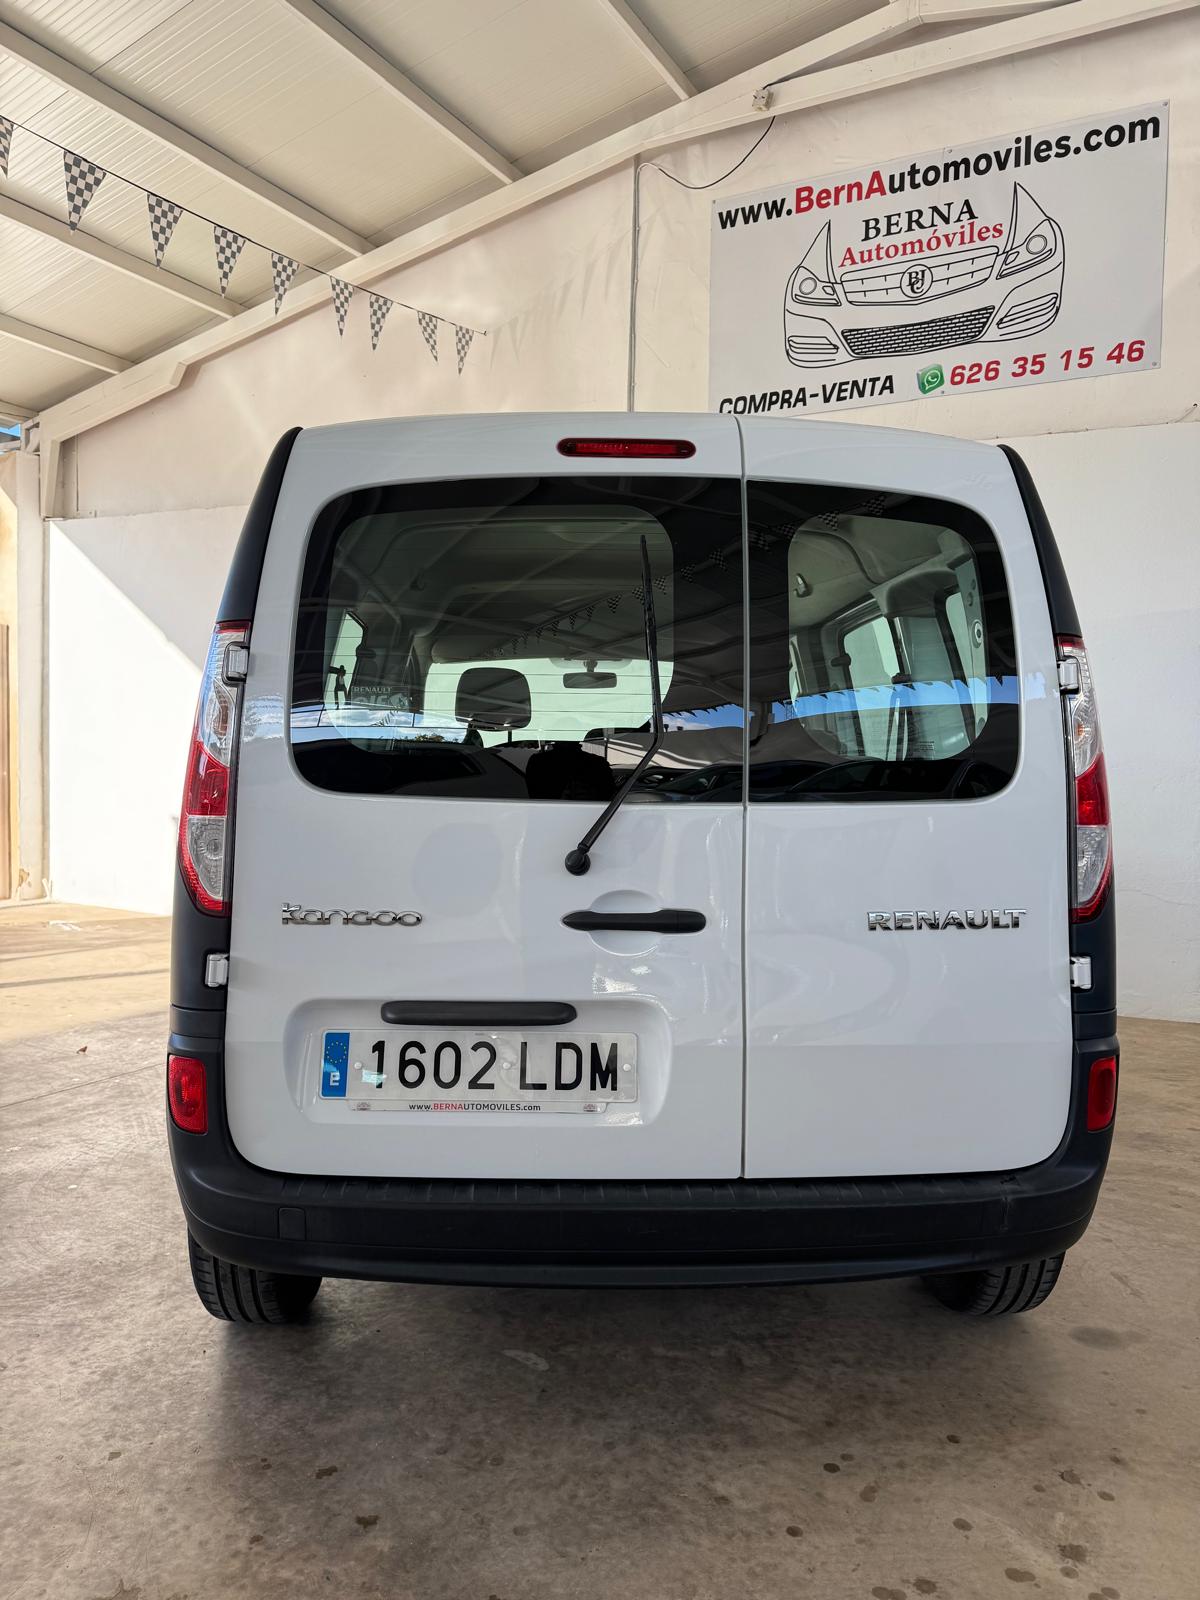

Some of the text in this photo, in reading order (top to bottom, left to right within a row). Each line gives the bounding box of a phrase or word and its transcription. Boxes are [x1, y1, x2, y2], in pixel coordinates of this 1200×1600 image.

[718, 116, 1160, 230] www.BernAutomoviles.com
[861, 198, 978, 242] BERNA
[838, 222, 1004, 268] Automóviles
[950, 340, 1145, 386] 626 35 15 46
[719, 375, 895, 414] COMPRA-VENTA
[867, 909, 1027, 931] RENAULT
[329, 1073, 339, 1086] E
[371, 1040, 618, 1091] 1602 LDM
[408, 1102, 541, 1112] www.BERNAUTOMOVILES.com
